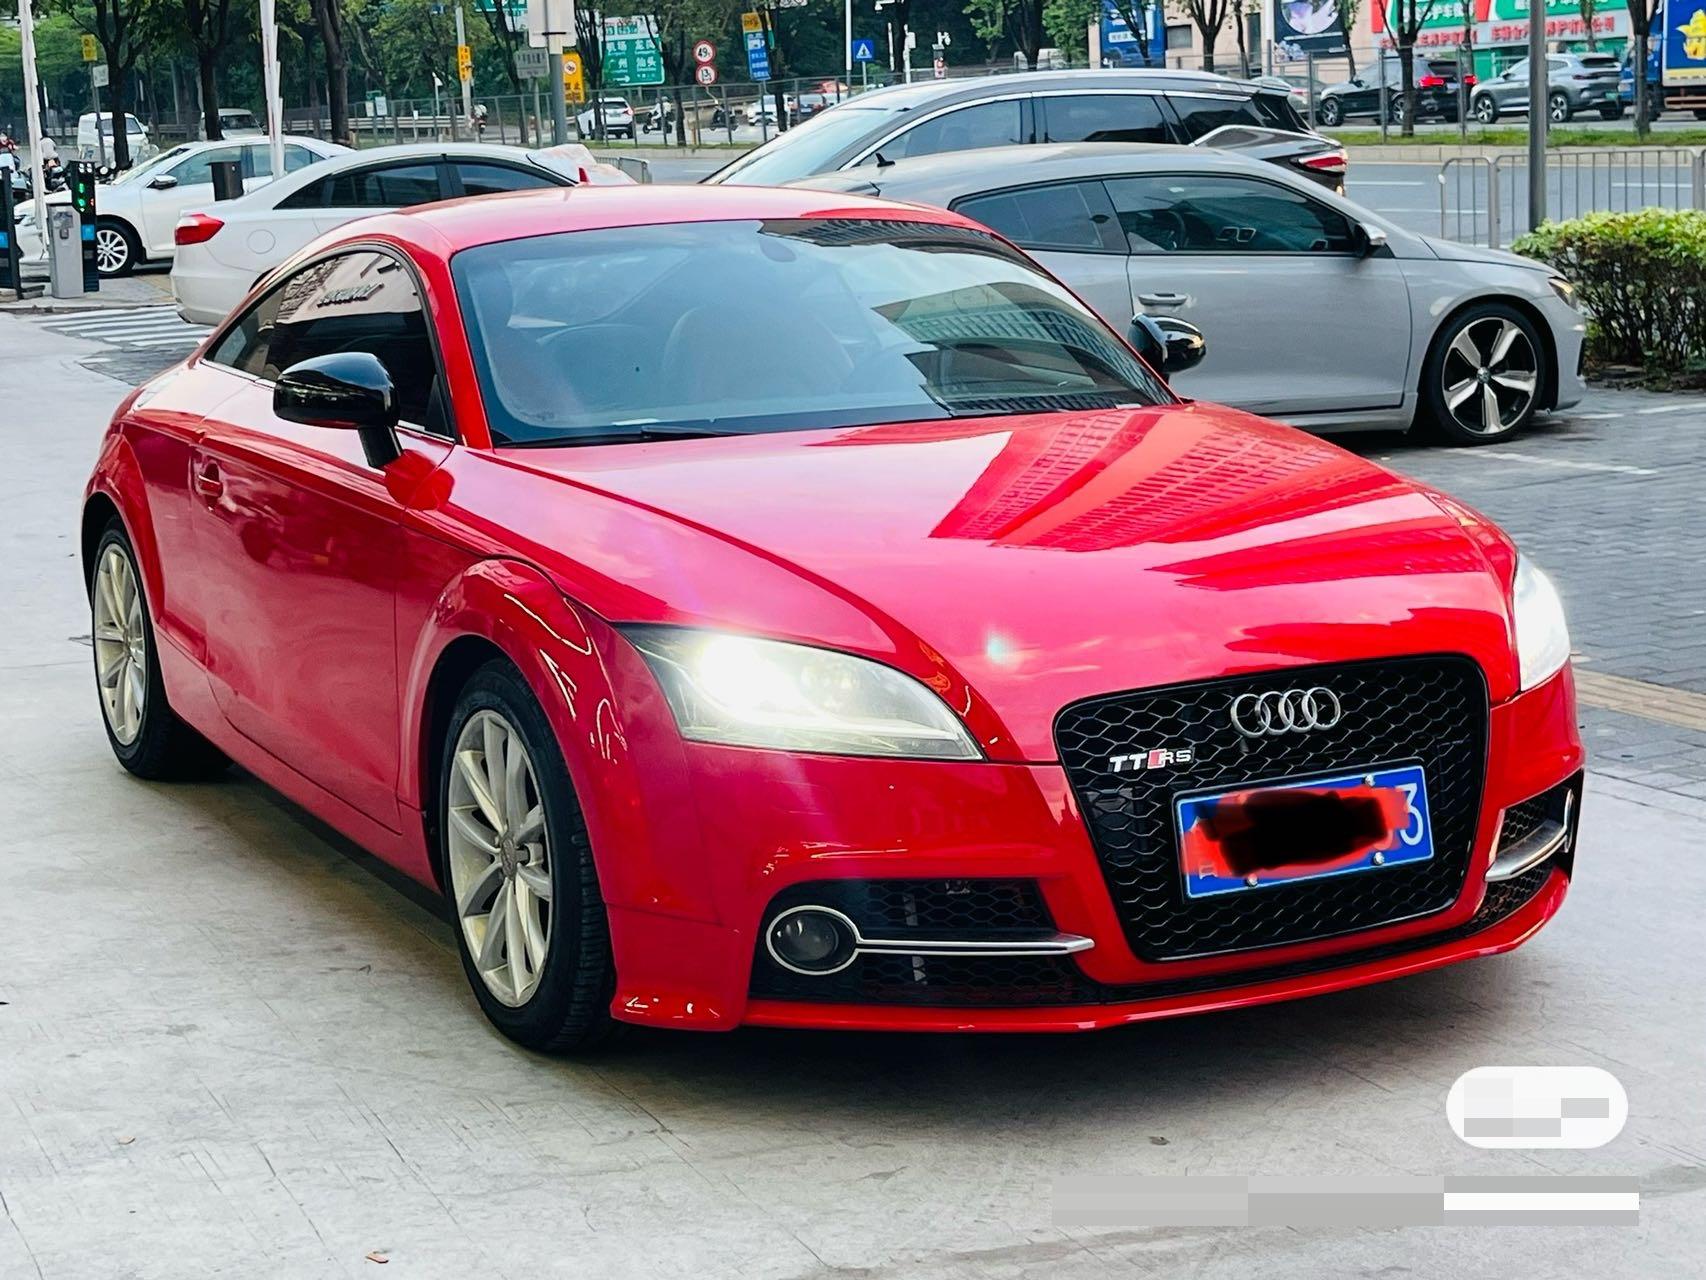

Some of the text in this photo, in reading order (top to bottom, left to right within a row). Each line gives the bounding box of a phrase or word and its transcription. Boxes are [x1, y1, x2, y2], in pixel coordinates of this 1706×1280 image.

[608, 56, 656, 69] 广州 汕头
[1109, 753, 1147, 773] TT
